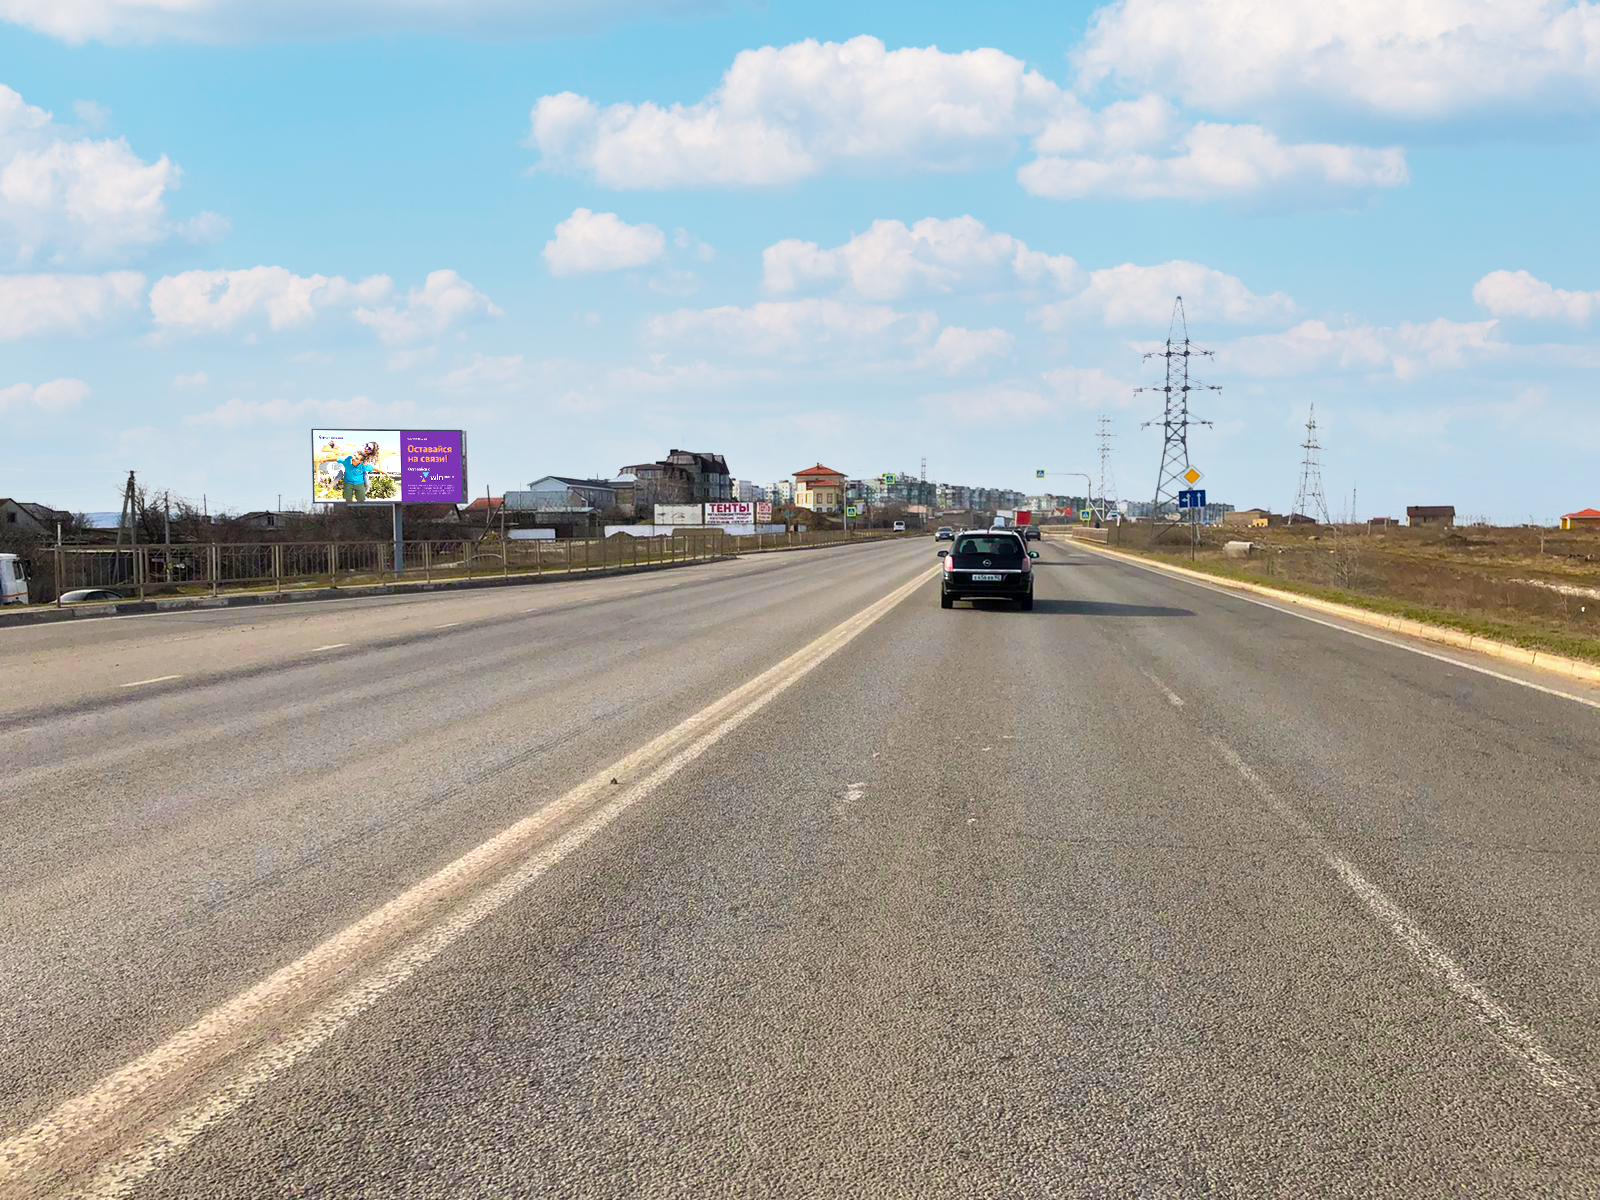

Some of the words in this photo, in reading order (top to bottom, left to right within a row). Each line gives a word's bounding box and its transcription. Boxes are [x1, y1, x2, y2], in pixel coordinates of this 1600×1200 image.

[407, 444, 452, 453] Оставайся
[420, 455, 448, 463] связи!
[709, 503, 750, 512] ТЕНТЫ
